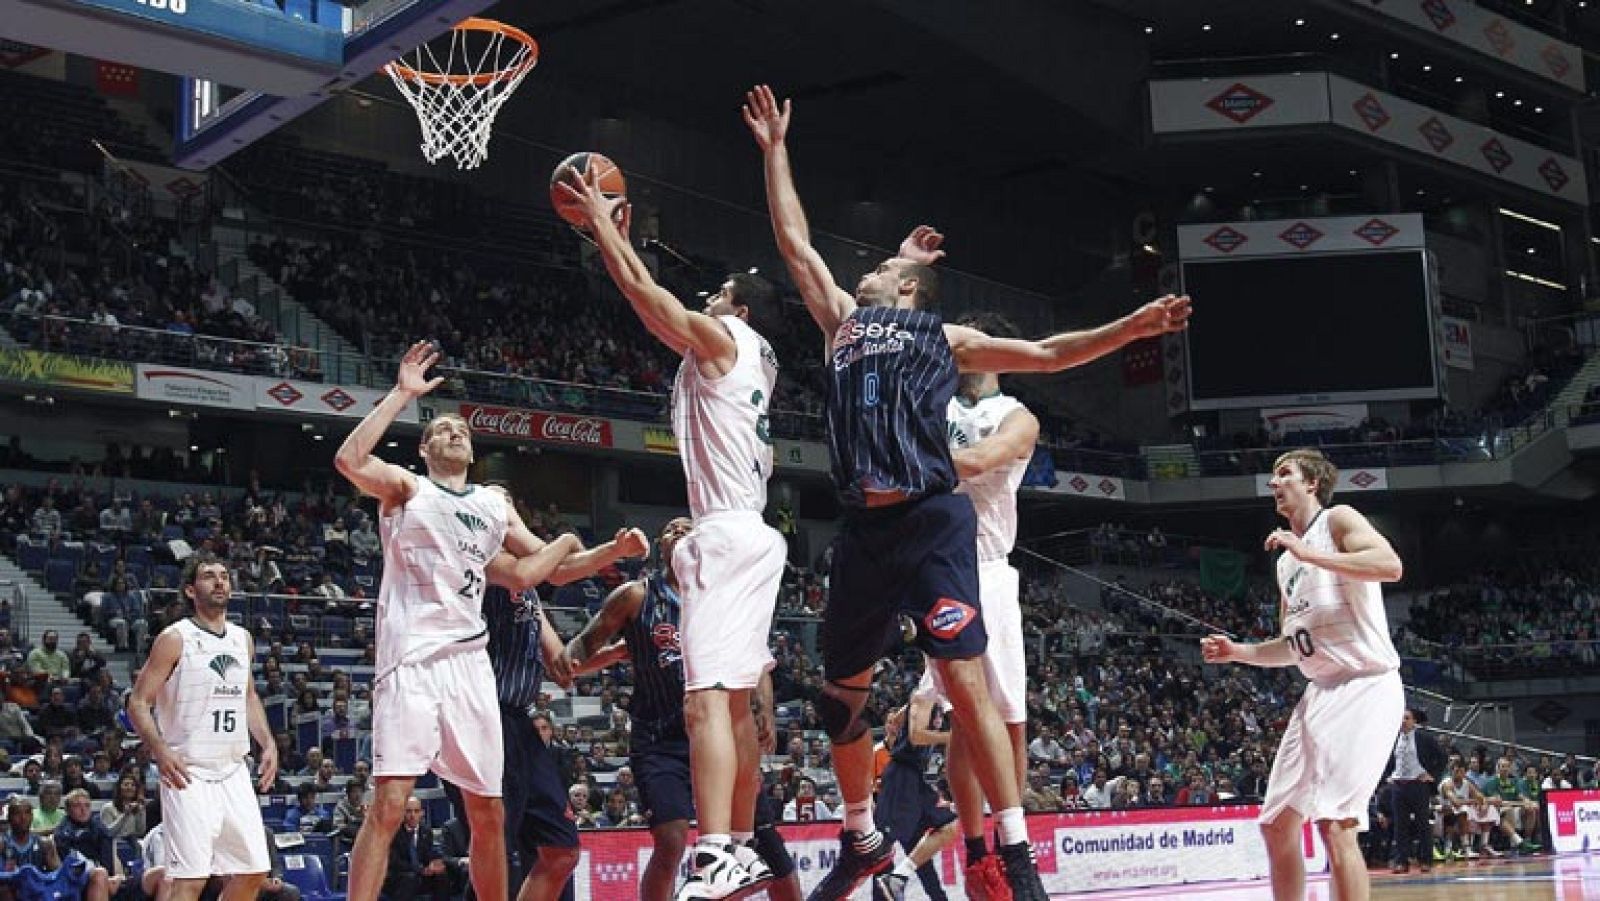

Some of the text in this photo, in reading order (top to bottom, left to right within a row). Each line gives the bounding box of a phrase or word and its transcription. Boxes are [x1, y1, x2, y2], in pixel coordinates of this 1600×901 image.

[864, 372, 880, 406] 0
[458, 568, 482, 599] 2
[212, 710, 236, 733] 15
[1061, 827, 1235, 854] Comunidad de Madrid
